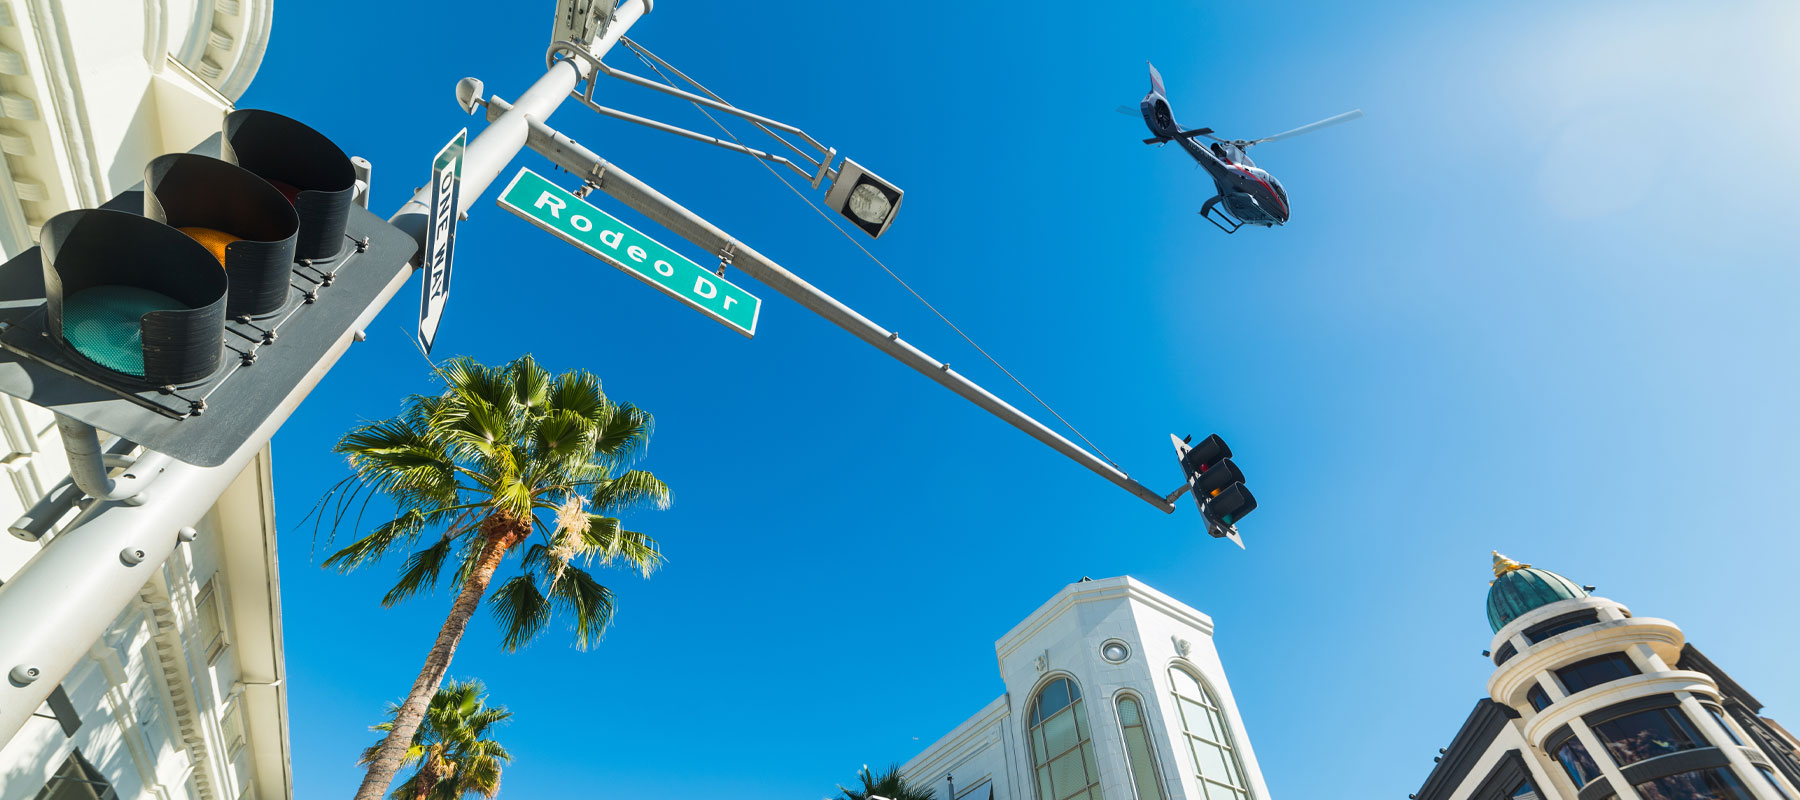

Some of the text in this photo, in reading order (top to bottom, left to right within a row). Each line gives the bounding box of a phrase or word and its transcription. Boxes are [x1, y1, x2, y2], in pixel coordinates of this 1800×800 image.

[430, 171, 453, 301] ONE WAY
[534, 190, 738, 311] Rodeo Dr
